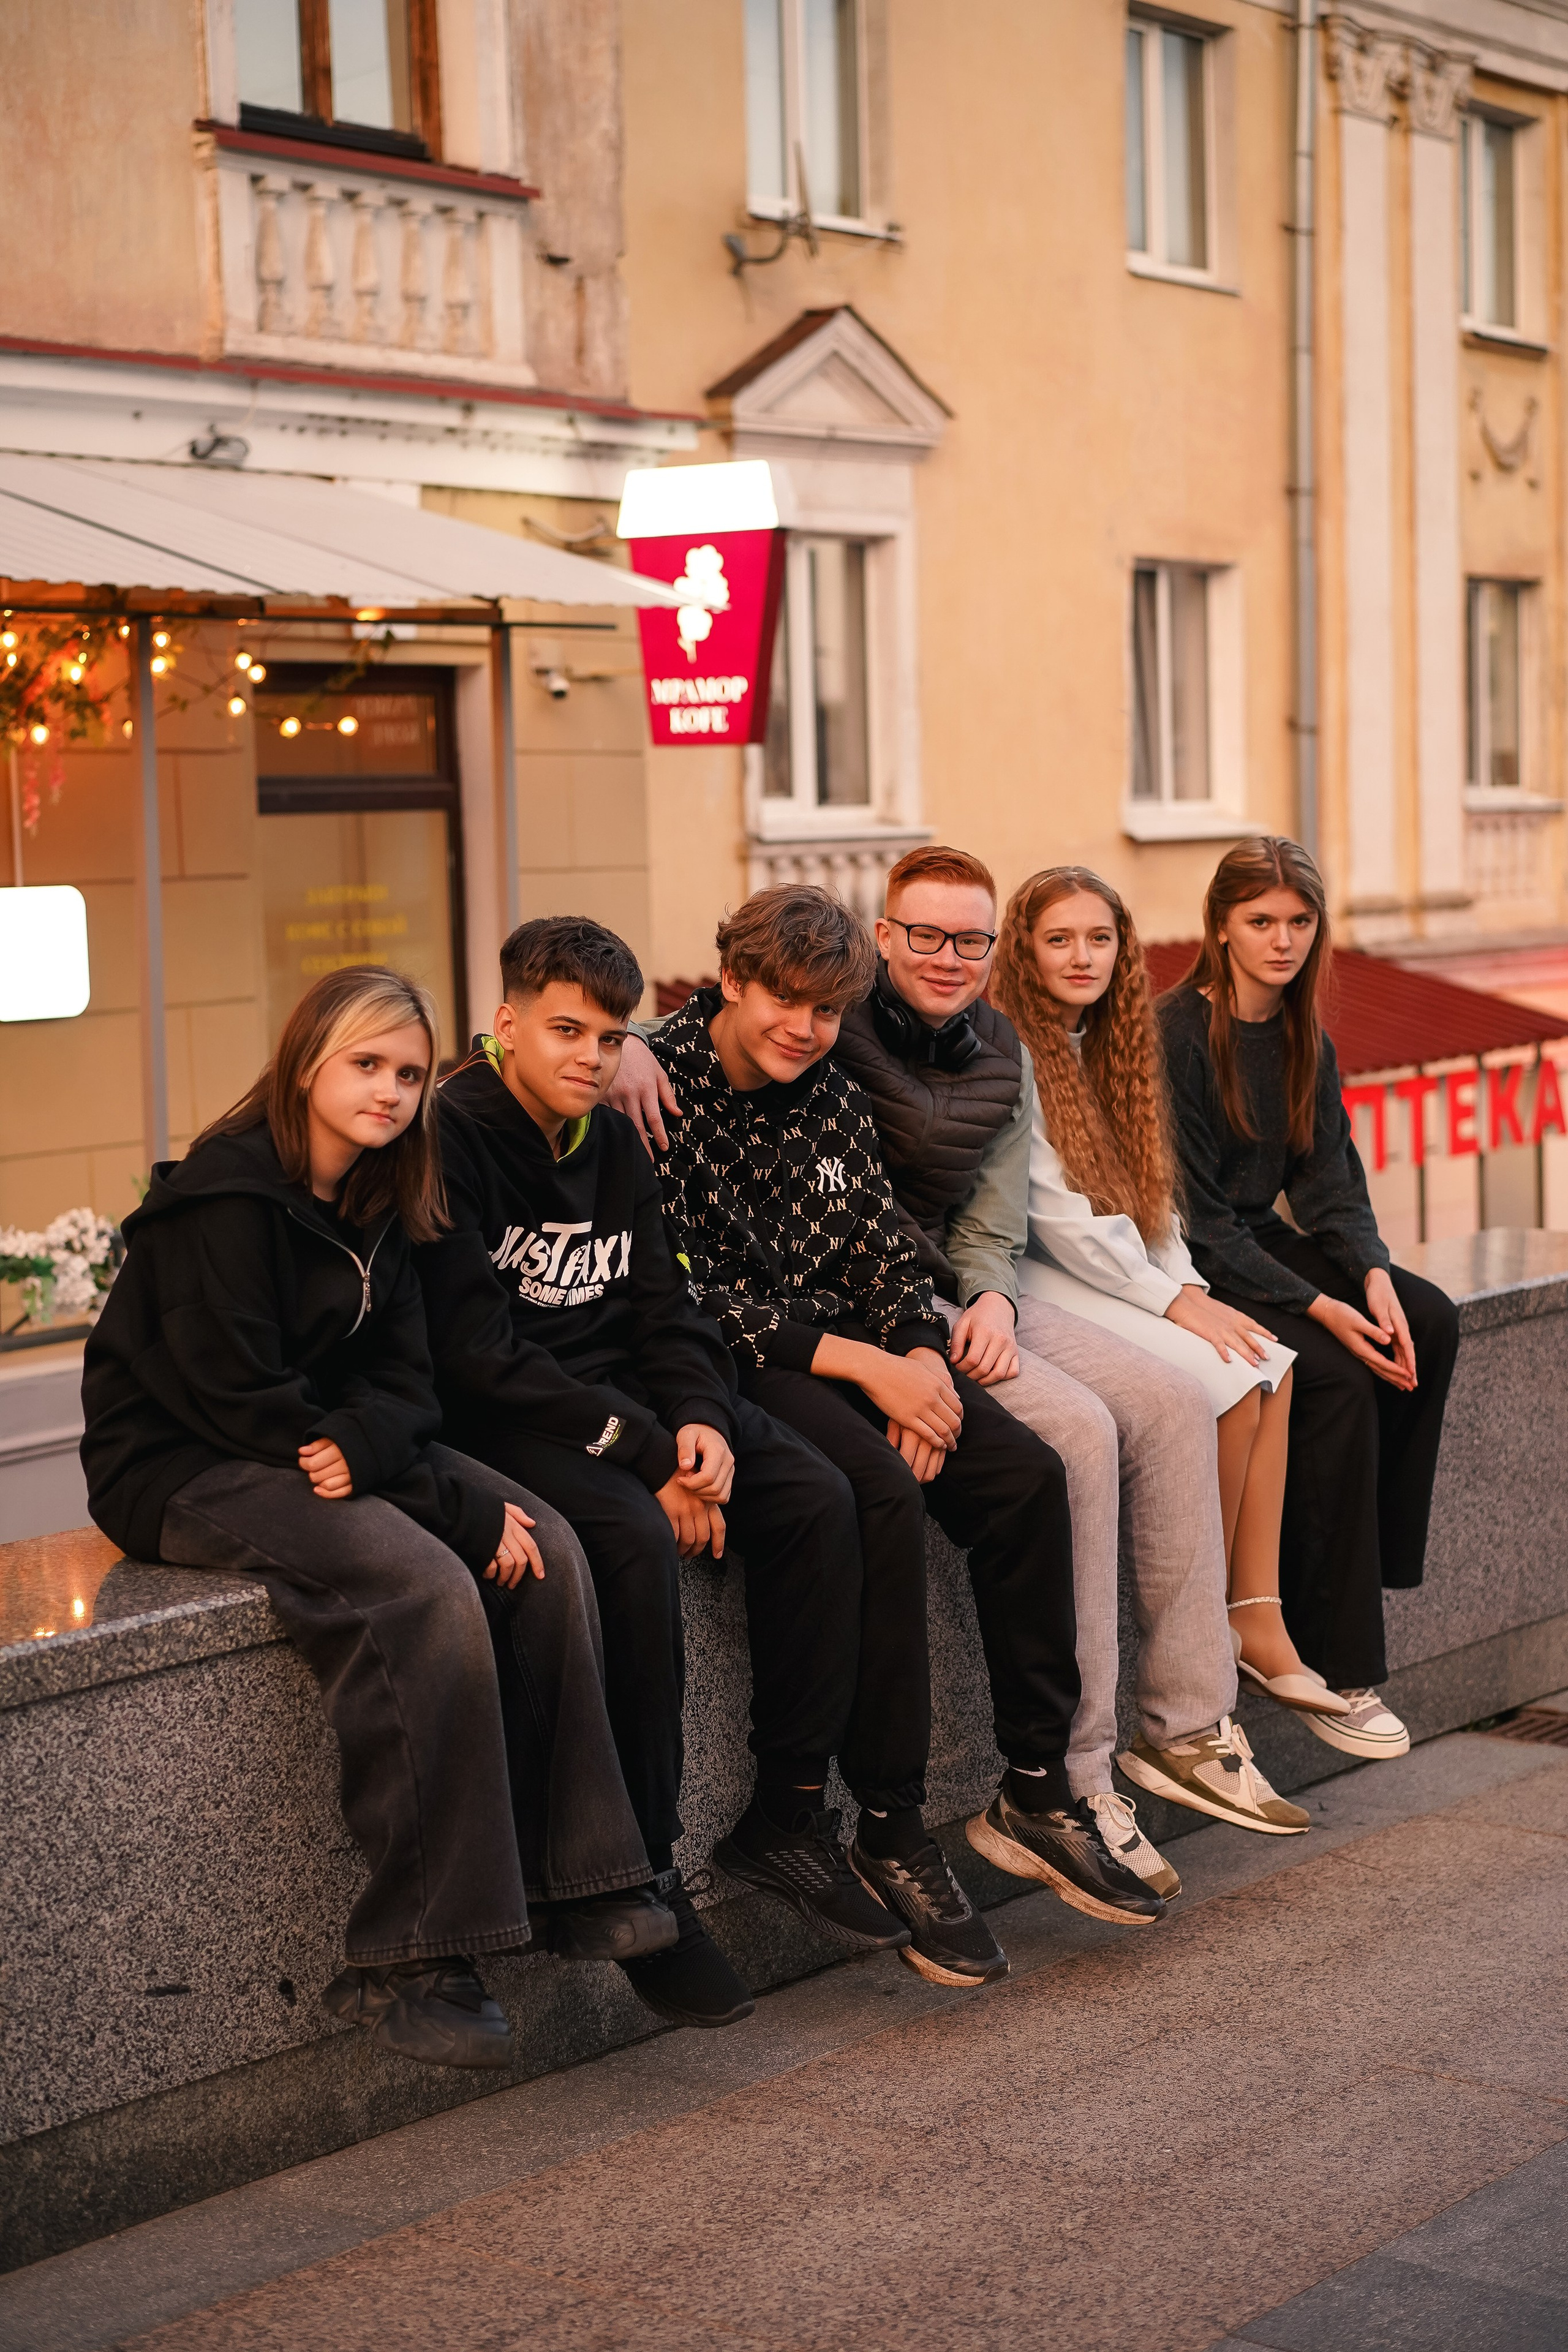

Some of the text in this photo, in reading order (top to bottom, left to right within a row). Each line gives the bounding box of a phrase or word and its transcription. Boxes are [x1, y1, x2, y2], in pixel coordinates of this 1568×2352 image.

[1341, 1060, 1567, 1172] ПТЕКА
[815, 1156, 847, 1194] NY
[519, 1294, 537, 1304] CALIFORNIA
